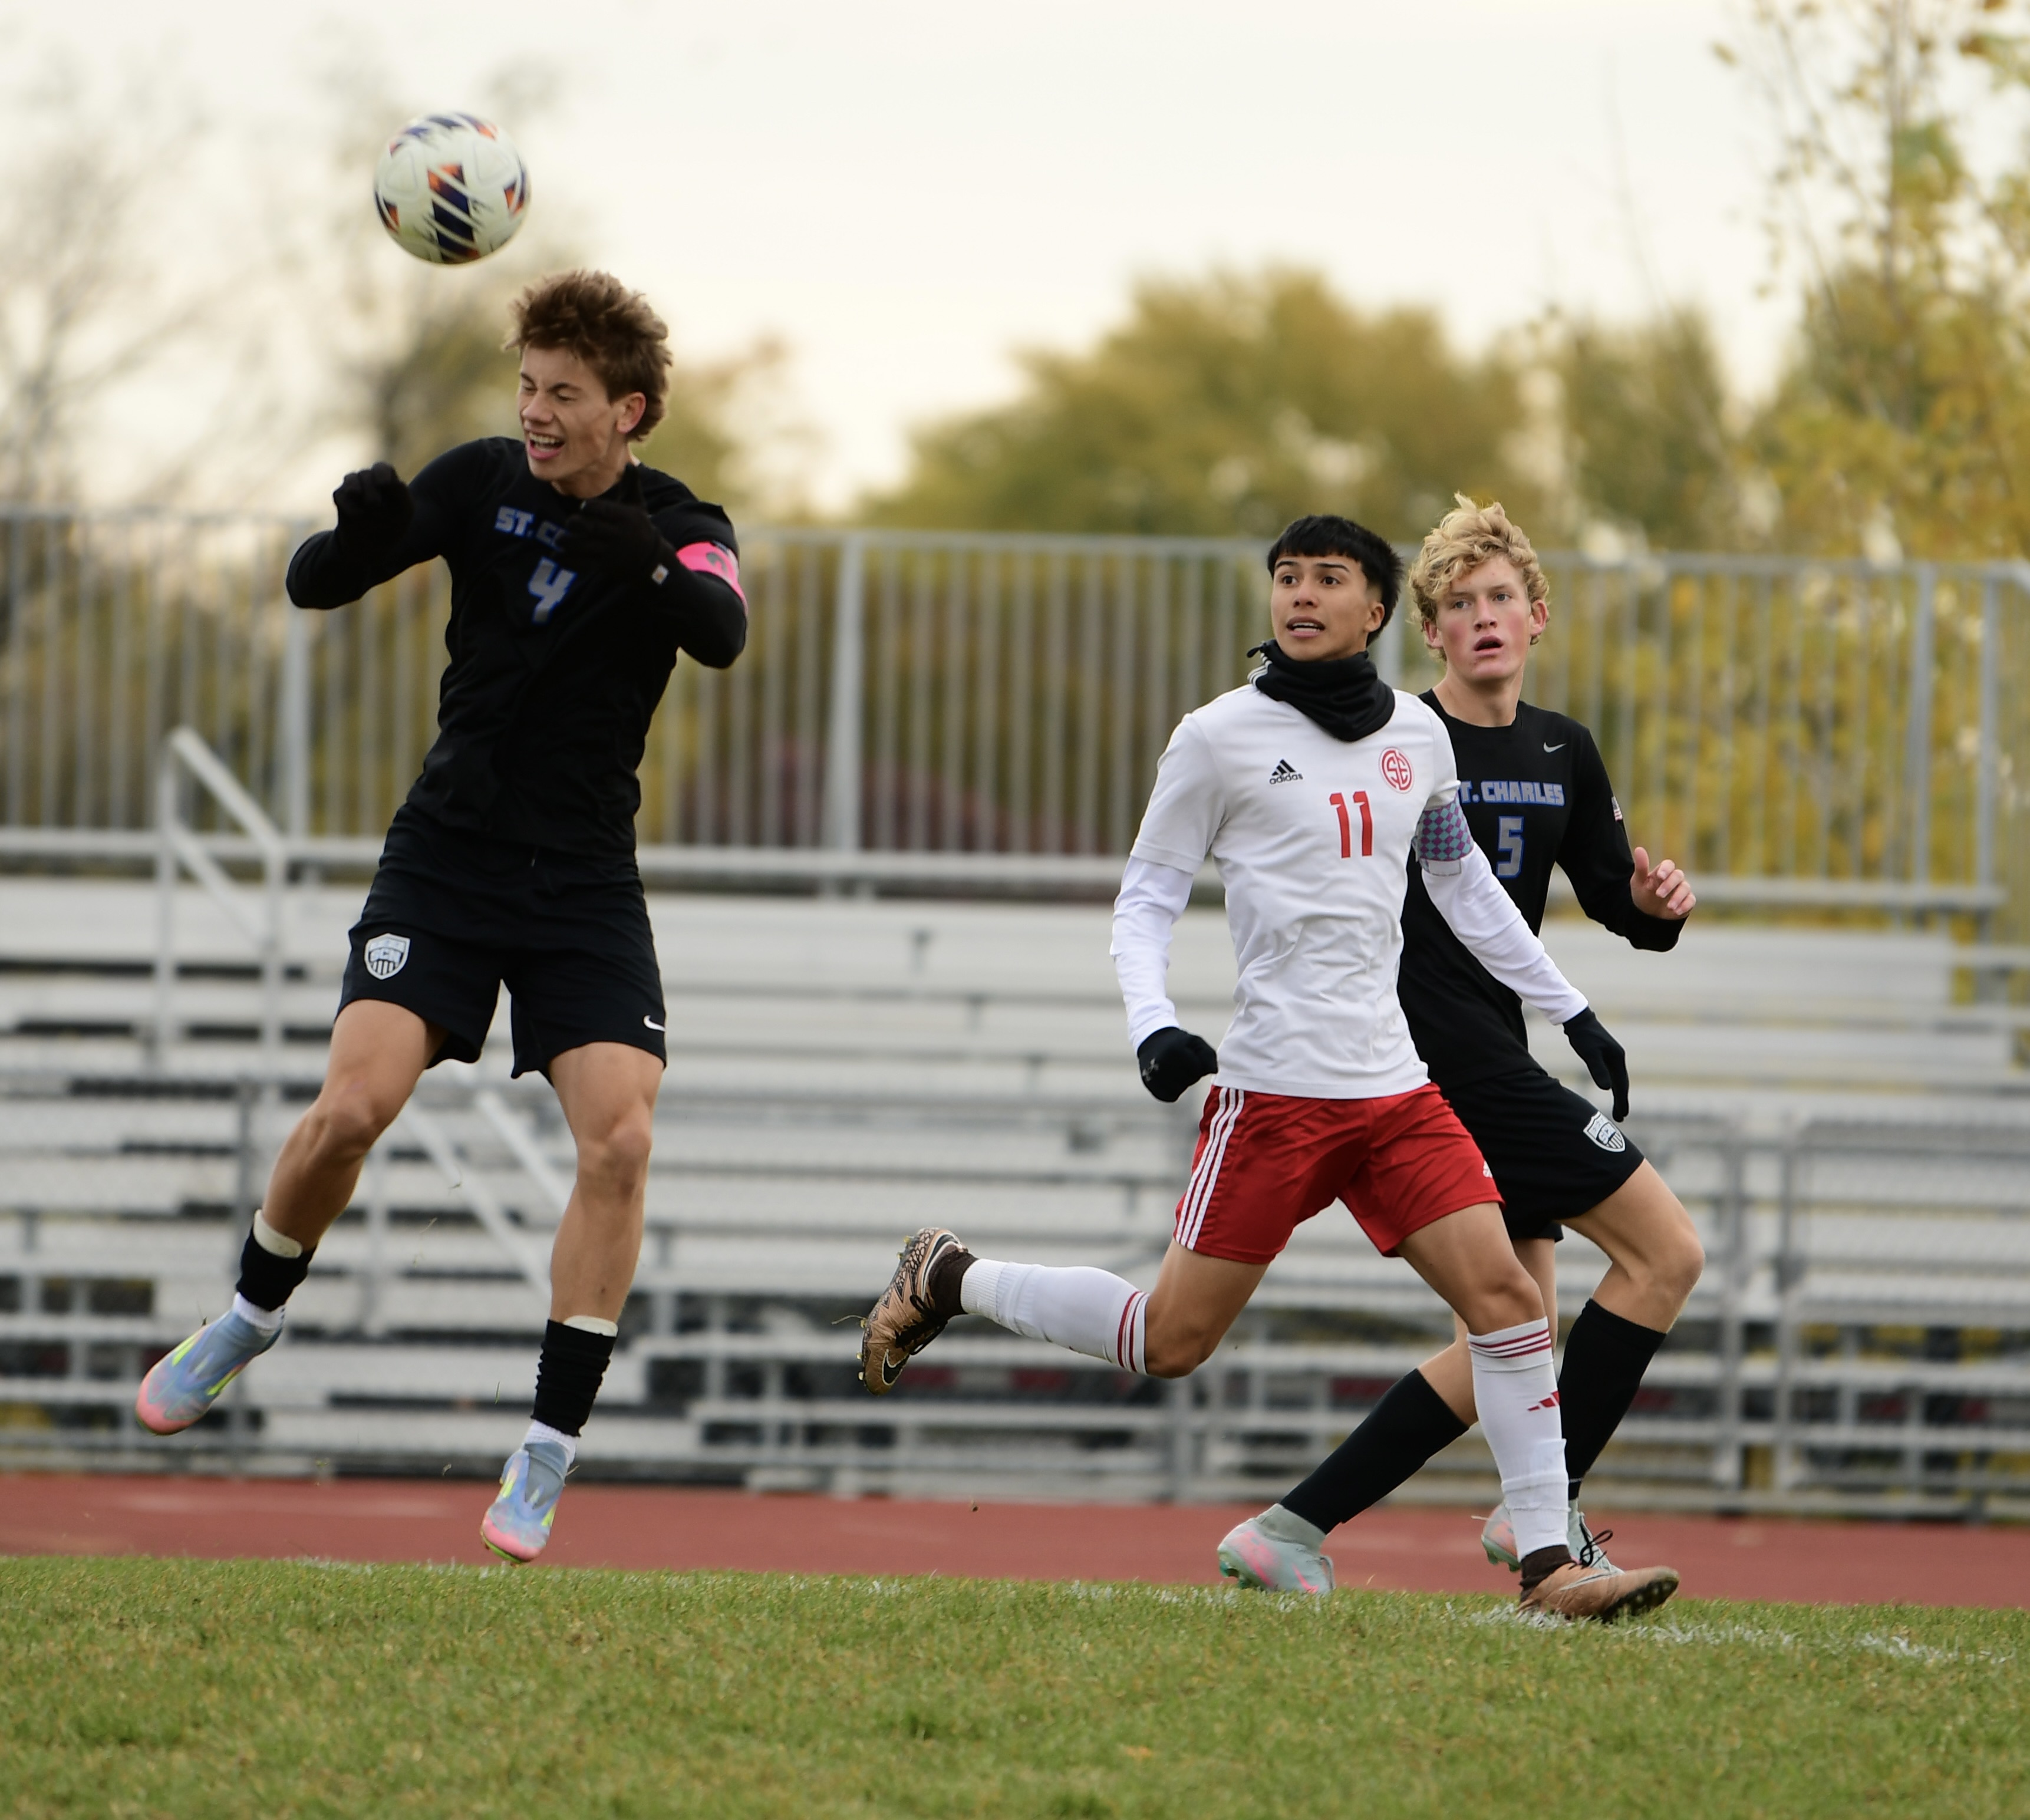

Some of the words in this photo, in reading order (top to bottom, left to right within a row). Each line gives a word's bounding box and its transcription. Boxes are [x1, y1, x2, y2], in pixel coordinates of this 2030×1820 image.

[528, 556, 577, 625] 4
[1269, 773, 1303, 784] adidas
[1459, 780, 1481, 804] T.
[1480, 780, 1565, 806] CHARLES
[1329, 790, 1373, 859] 11
[1496, 815, 1524, 879] 5
